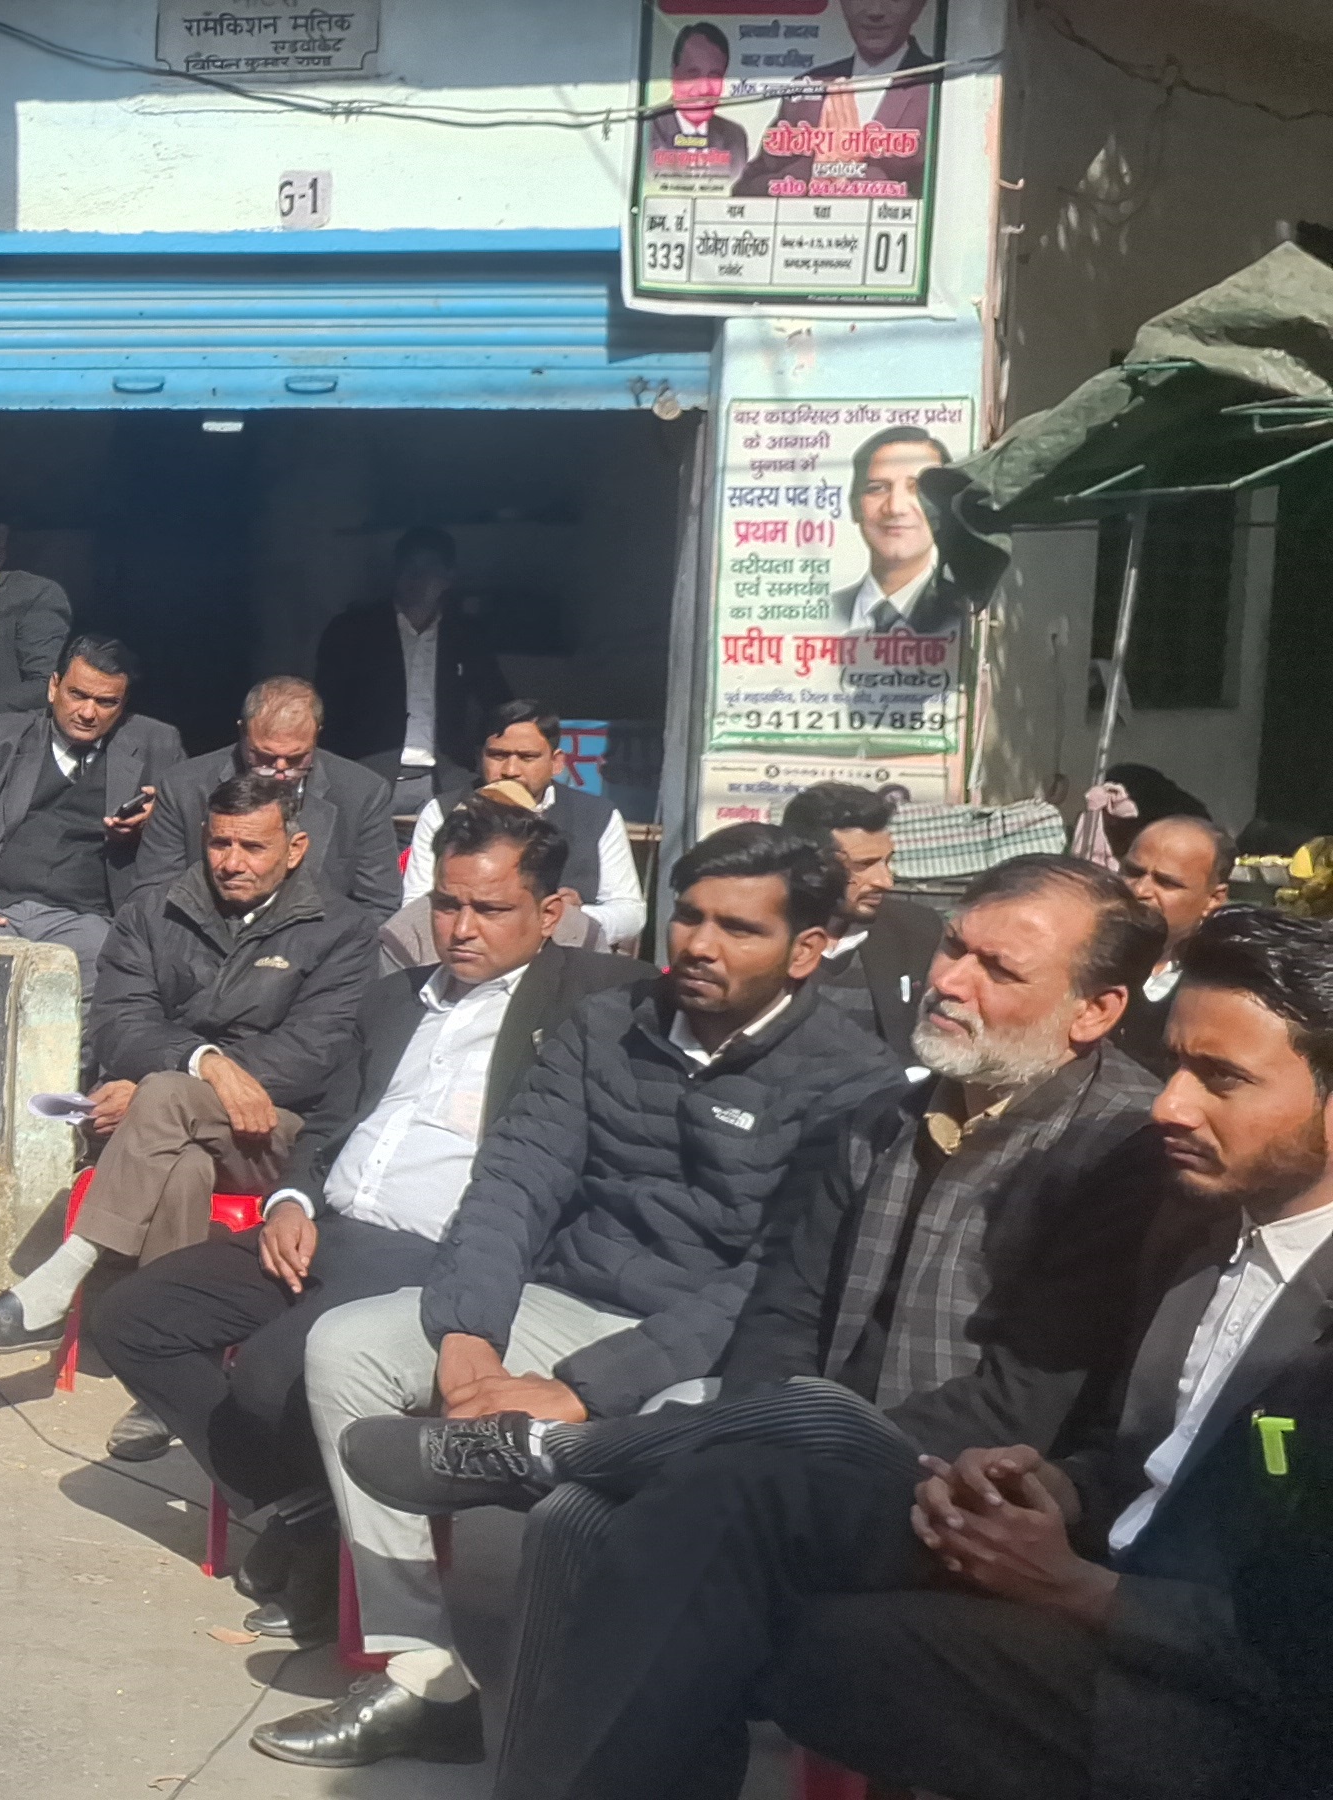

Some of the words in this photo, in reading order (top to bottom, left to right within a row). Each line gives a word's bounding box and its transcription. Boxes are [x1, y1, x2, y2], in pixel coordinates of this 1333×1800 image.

[764, 122, 833, 156] योगेश
[841, 121, 920, 158] मलिक
[279, 177, 318, 217] G-1
[647, 242, 685, 270] 333
[874, 231, 908, 272] 01
[844, 406, 881, 424] ऑफ
[886, 410, 921, 425] उत्तर
[924, 404, 962, 424] प्रदेश
[743, 431, 761, 449] के
[765, 430, 830, 450] आगामी
[750, 458, 796, 479] चुनाव
[728, 485, 779, 508] सदस्य
[785, 485, 810, 508] पद
[816, 479, 842, 518] हेतु
[735, 520, 788, 546] प्रथम
[795, 519, 835, 547] (01)
[731, 553, 794, 574] वरीयता
[799, 557, 830, 573] मत
[765, 576, 830, 598] समर्थन
[730, 605, 751, 620] का
[722, 626, 783, 666] प्रदीप
[793, 635, 859, 677] कुमार
[840, 668, 951, 692] (एडवोकेट)
[745, 710, 947, 731] 9412107859
